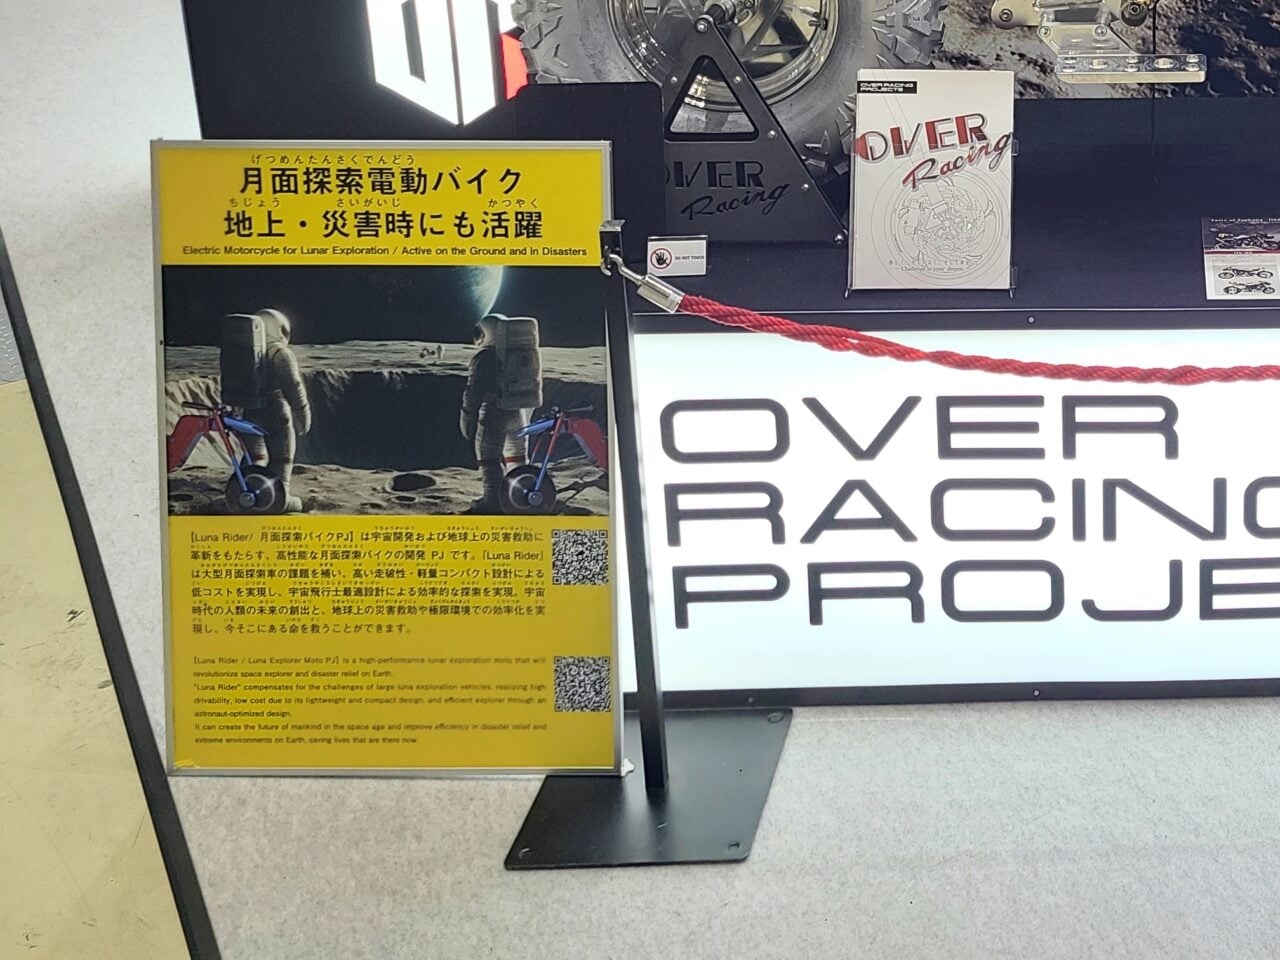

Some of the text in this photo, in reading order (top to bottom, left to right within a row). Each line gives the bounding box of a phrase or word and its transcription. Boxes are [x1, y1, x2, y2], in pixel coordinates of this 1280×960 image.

[853, 112, 989, 161] OVER
[251, 154, 415, 165] げつめんたんさくでんどう
[665, 159, 765, 189] VER
[902, 130, 1014, 190] Racing
[240, 166, 522, 195] 月面探索電動バイク
[229, 197, 538, 208] ちじょう さいがいじ かつやく
[681, 183, 790, 222] Racing
[223, 210, 543, 239] 地上・災害時にも活躍
[182, 246, 220, 255] Electric
[224, 246, 280, 256] Motorcycle
[283, 246, 297, 254] for
[300, 246, 329, 255] Lunar
[332, 246, 389, 256] Exploration
[401, 246, 432, 255] Active
[451, 247, 466, 255] the
[469, 246, 506, 255] Ground
[509, 247, 527, 255] and
[542, 247, 587, 256] Disasters
[659, 394, 1179, 463] OVER
